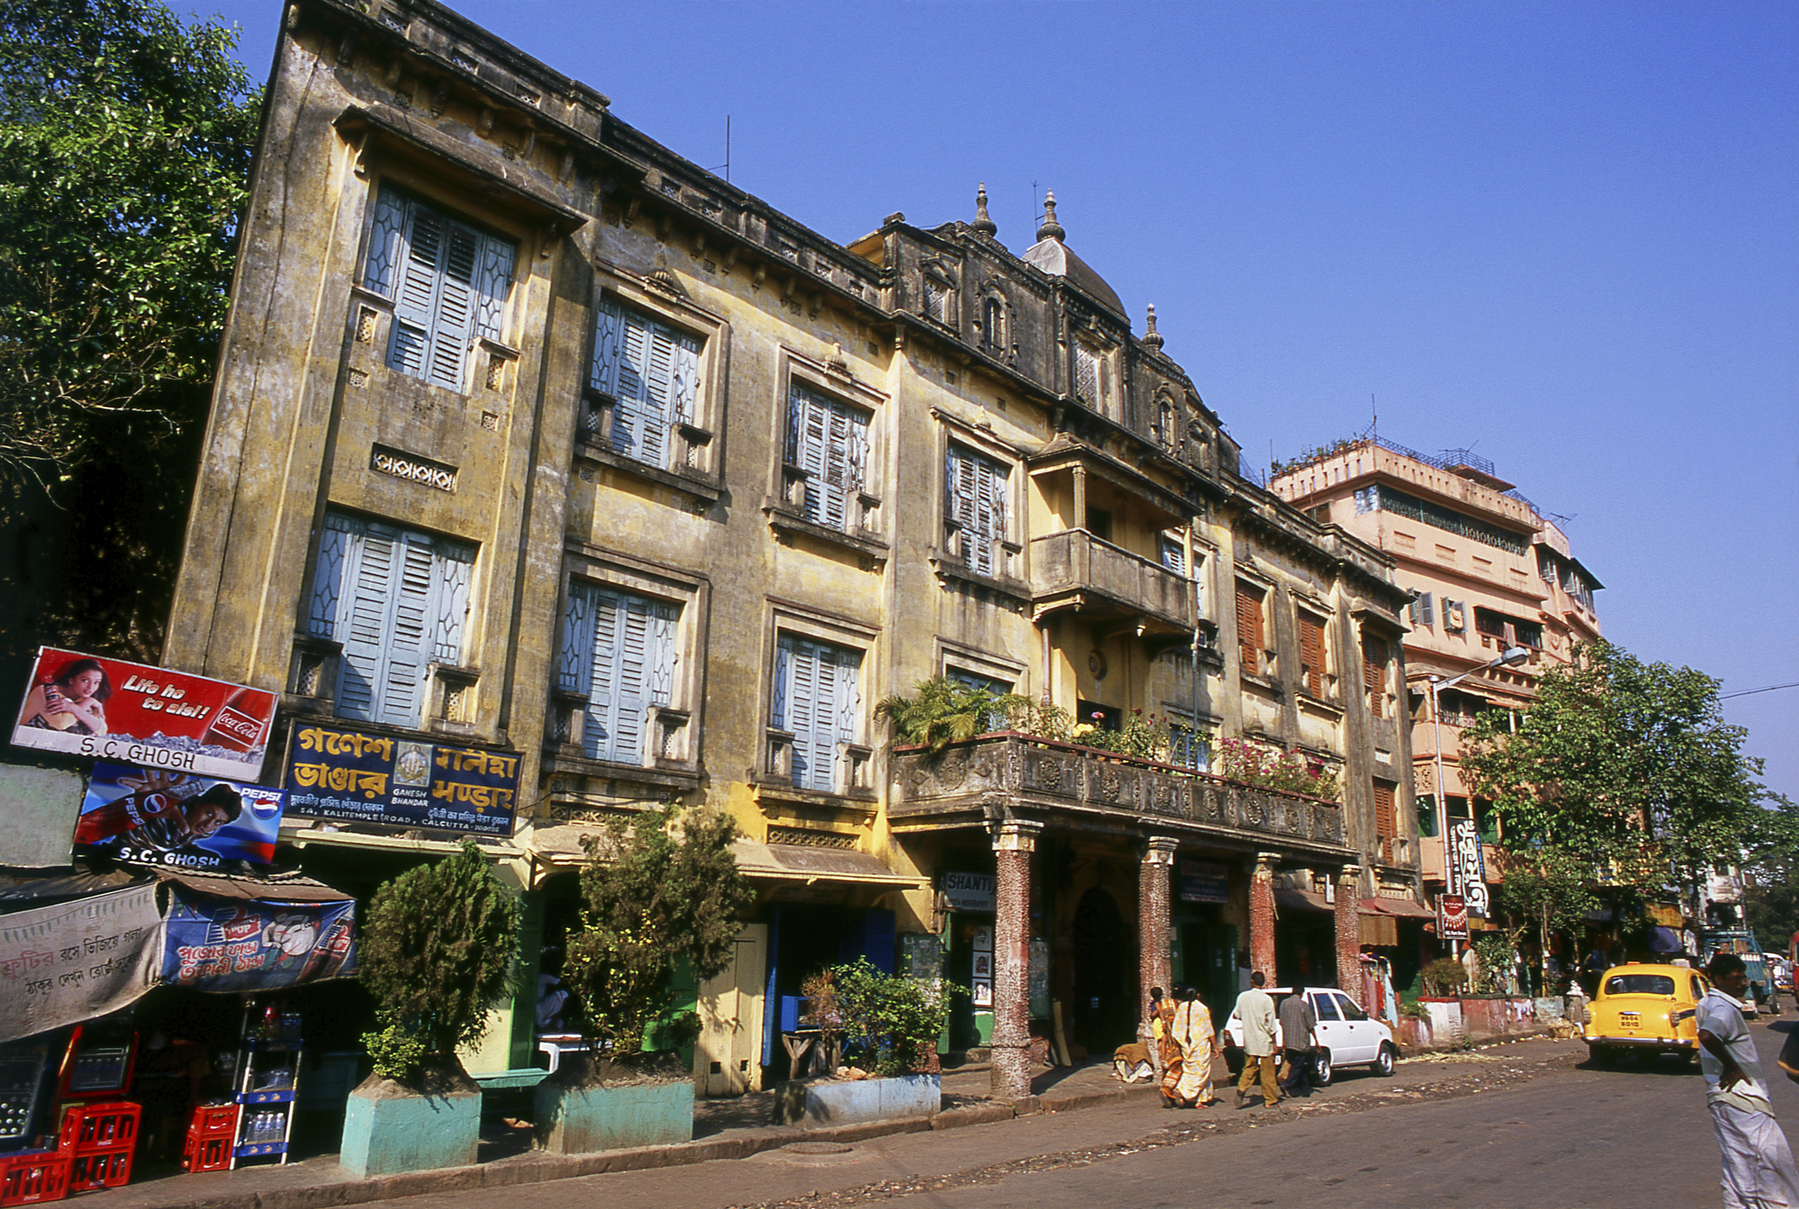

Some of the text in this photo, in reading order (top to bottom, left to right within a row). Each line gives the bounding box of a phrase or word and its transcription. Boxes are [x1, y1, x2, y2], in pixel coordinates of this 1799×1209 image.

[122, 674, 186, 701] Life ho
[142, 696, 212, 720] to aisi!
[298, 727, 395, 763] গণেশ
[127, 744, 197, 770] GHOSH
[239, 786, 283, 802] PEPSI
[390, 796, 430, 808] BHANDAR
[392, 788, 427, 799] GANESH
[124, 796, 146, 827] PEPSI
[323, 809, 379, 821] KALITEMPLE
[163, 852, 221, 867] GHOSH
